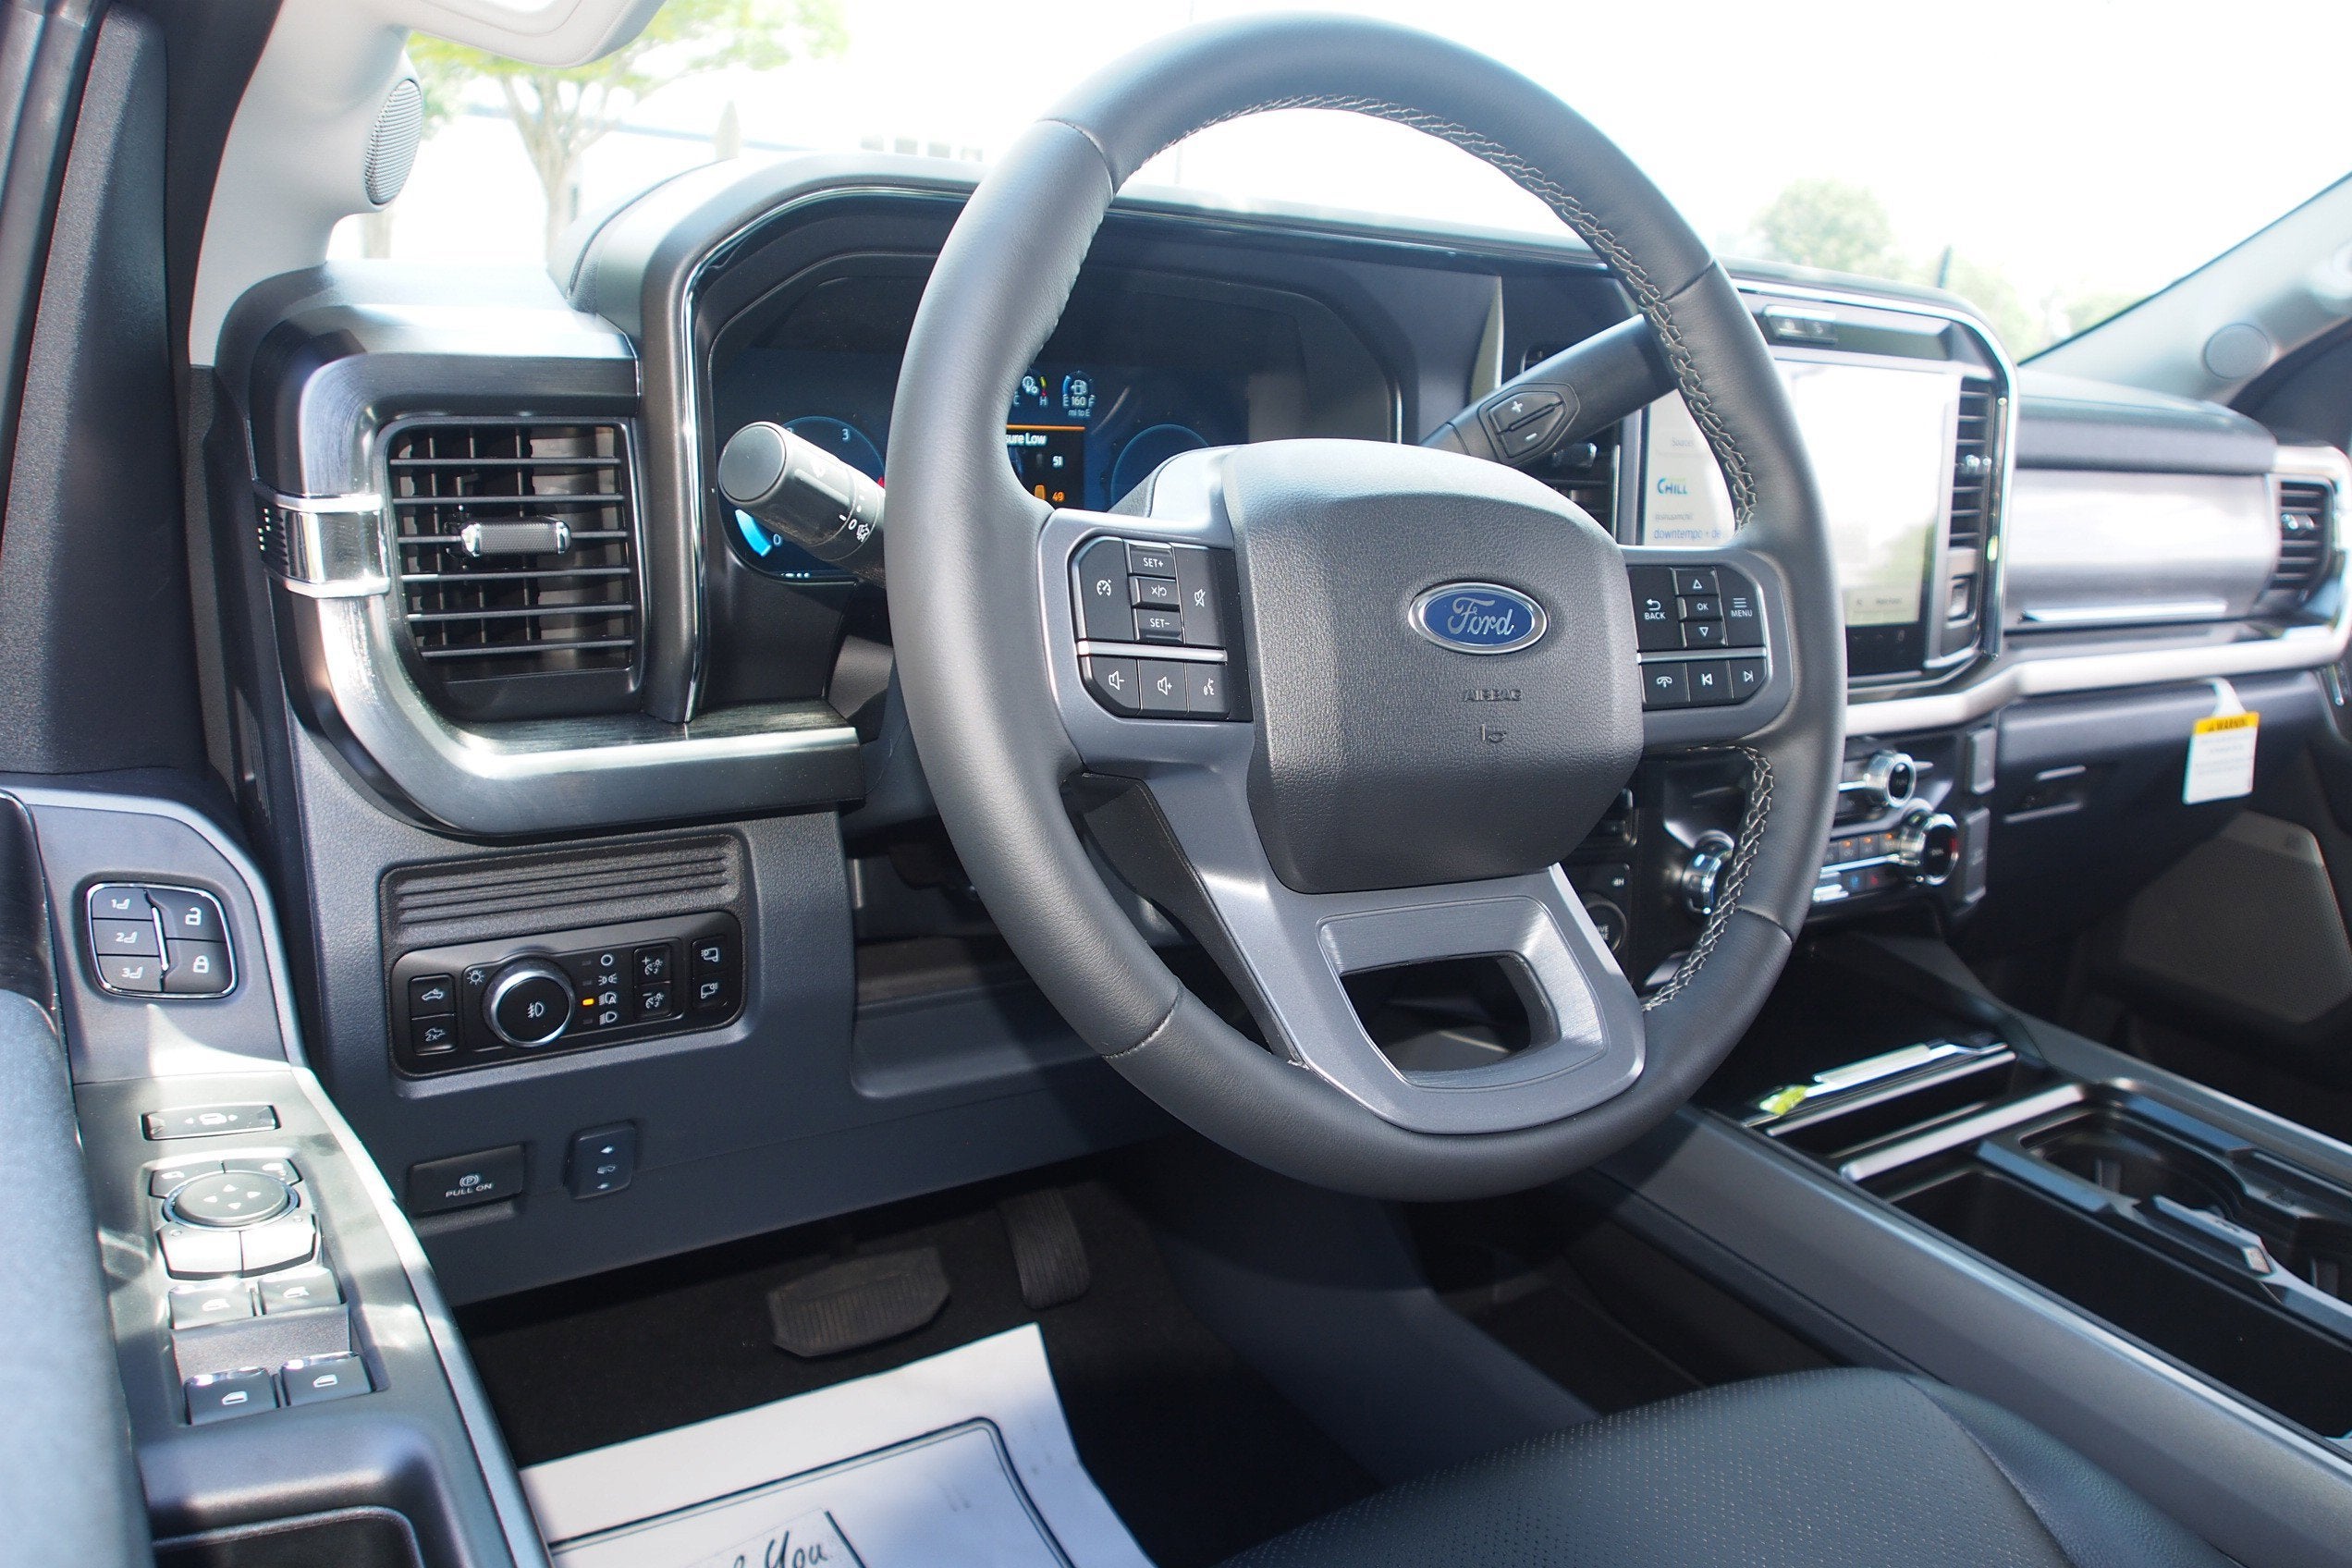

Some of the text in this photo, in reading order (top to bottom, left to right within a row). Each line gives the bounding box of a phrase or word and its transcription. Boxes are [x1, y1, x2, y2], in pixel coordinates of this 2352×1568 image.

[1039, 397, 1047, 406] H
[1071, 396, 1087, 406] 160
[841, 428, 850, 441] 3
[1025, 433, 1047, 444] Low
[1052, 456, 1063, 468] 51
[1657, 478, 1687, 495] CHILL
[773, 534, 782, 545] 0
[1143, 557, 1164, 568] SET+
[1697, 602, 1709, 611] OK
[1447, 596, 1515, 636] Ford
[1644, 612, 1666, 620] BACK
[1731, 609, 1753, 618] MENU
[445, 1183, 492, 1198] PULL ON
